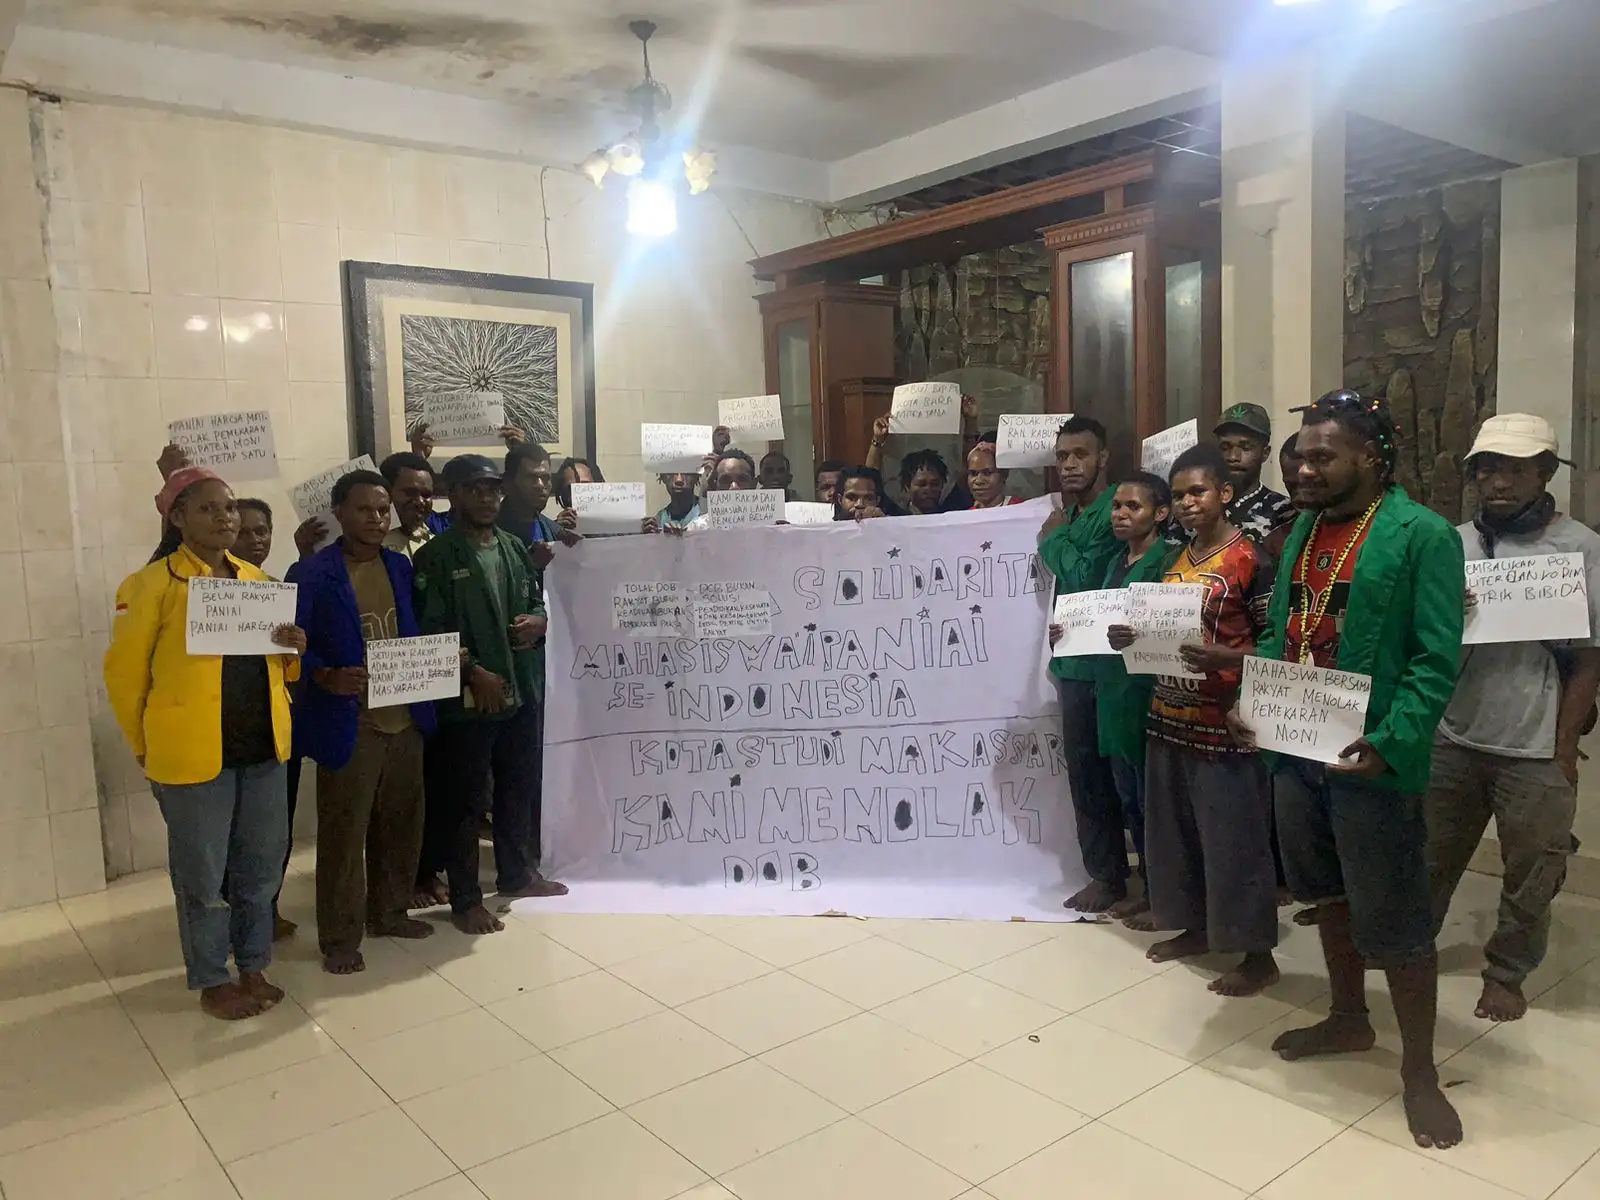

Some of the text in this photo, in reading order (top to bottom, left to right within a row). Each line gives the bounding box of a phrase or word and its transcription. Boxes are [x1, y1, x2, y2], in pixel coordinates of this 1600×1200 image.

[1547, 555, 1571, 567] POS
[191, 578, 248, 591] PEMEKARAN
[656, 582, 677, 593] DOB
[793, 552, 1054, 611] SOLIDARITA
[1524, 580, 1586, 601] BIBIDA
[202, 591, 278, 603] BELAH RAKYAT
[205, 604, 242, 618] PANIAI
[190, 620, 228, 637] PANIAI
[238, 621, 276, 633] HARGA
[1245, 658, 1320, 683] MAHASWA
[1251, 679, 1360, 712] RAKYAT MENOLAK
[1251, 698, 1330, 724] PEMEKARAN
[1274, 722, 1318, 747] MONI
[758, 776, 1042, 846] MENOLAK
[723, 850, 822, 892] DOB
